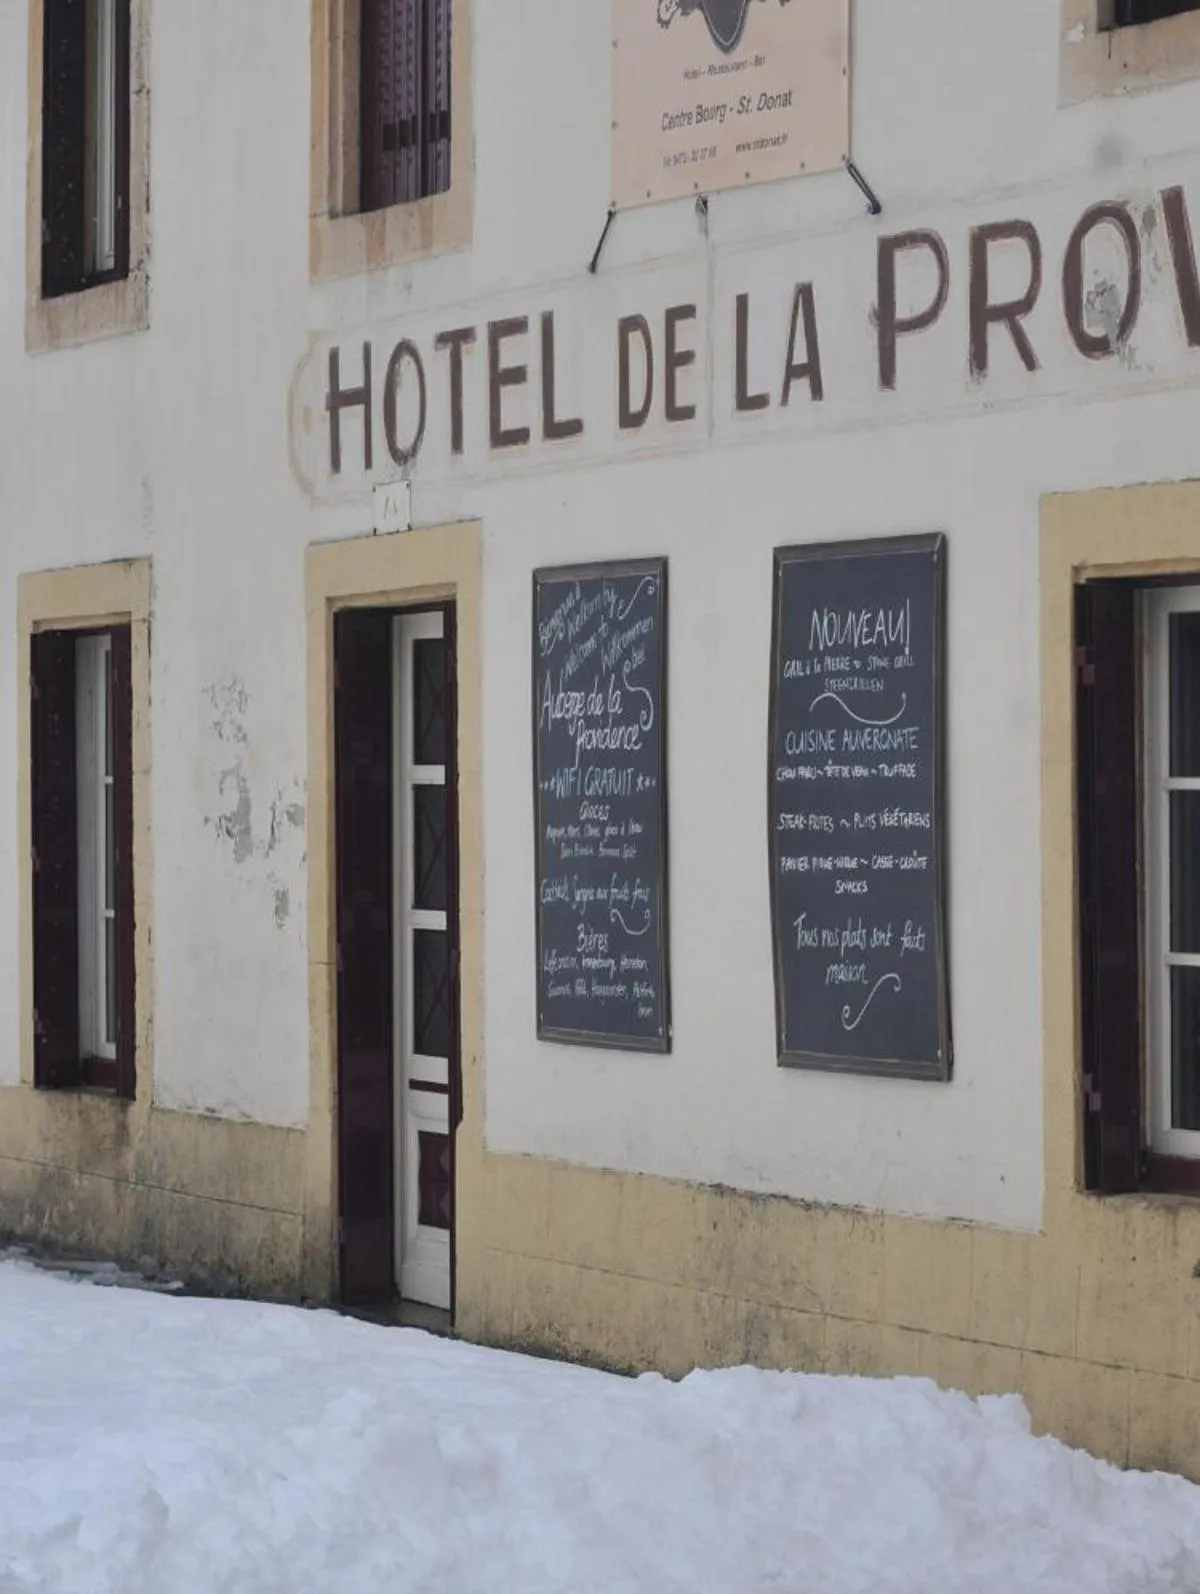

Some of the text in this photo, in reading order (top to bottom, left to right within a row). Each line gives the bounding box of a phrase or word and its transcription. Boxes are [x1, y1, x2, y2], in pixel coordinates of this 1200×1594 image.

[661, 89, 792, 132] Centre Bourg St. Donat
[325, 310, 583, 474] HOTEL
[618, 303, 696, 430] DE
[735, 281, 823, 411] LA
[809, 598, 910, 656] NOUVEAU!
[587, 674, 604, 716] de
[607, 673, 623, 714] la
[786, 727, 920, 755] CUISINE AUVERGNATE
[584, 766, 634, 797] GRATUIT
[834, 879, 868, 895] SNACKS
[793, 912, 819, 950] Tous
[821, 926, 840, 949] nos
[841, 917, 867, 957] plats
[870, 922, 892, 949] sont
